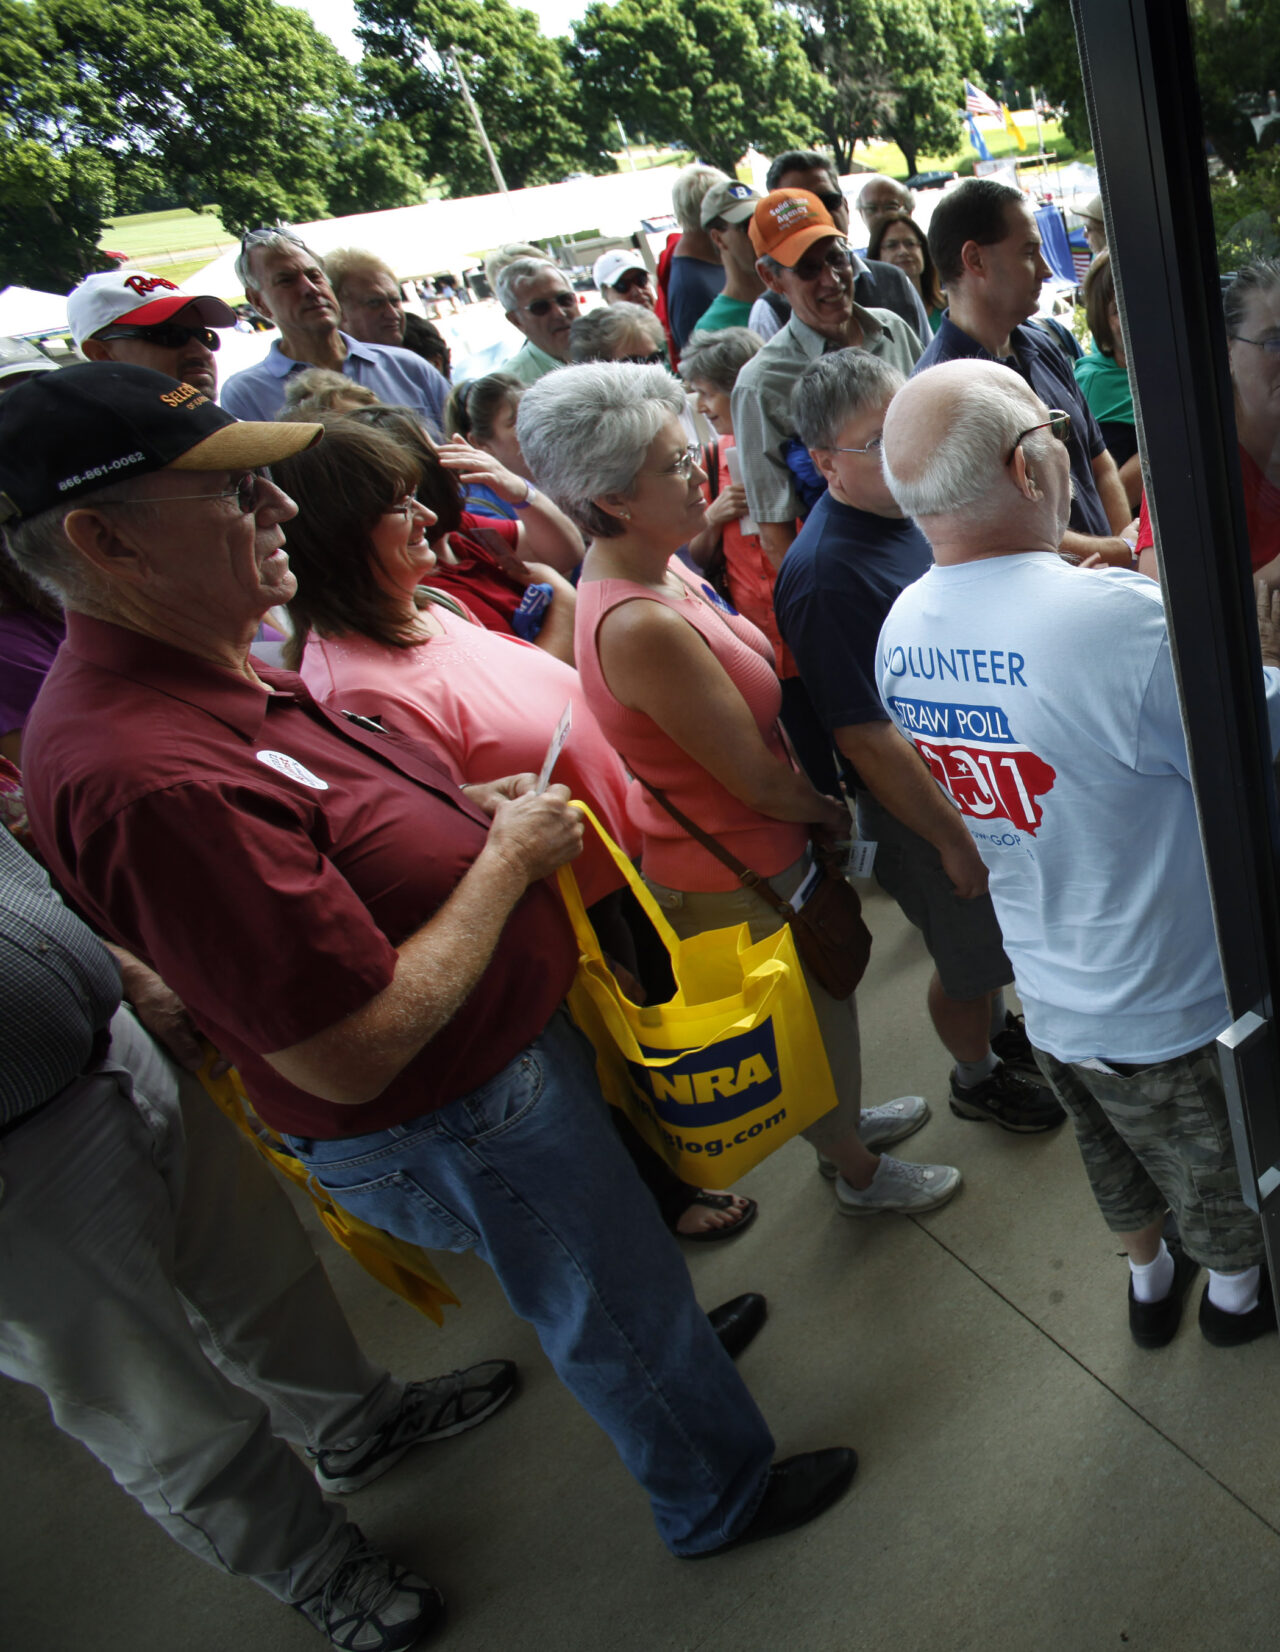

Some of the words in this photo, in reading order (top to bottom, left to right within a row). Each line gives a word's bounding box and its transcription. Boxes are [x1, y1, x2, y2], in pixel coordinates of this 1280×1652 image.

[58, 451, 146, 491] 866-861-0062
[884, 646, 1028, 687] VOLUNTEER
[894, 701, 949, 733] STRAW
[955, 709, 1009, 739] POLL
[649, 1052, 773, 1105] NRA
